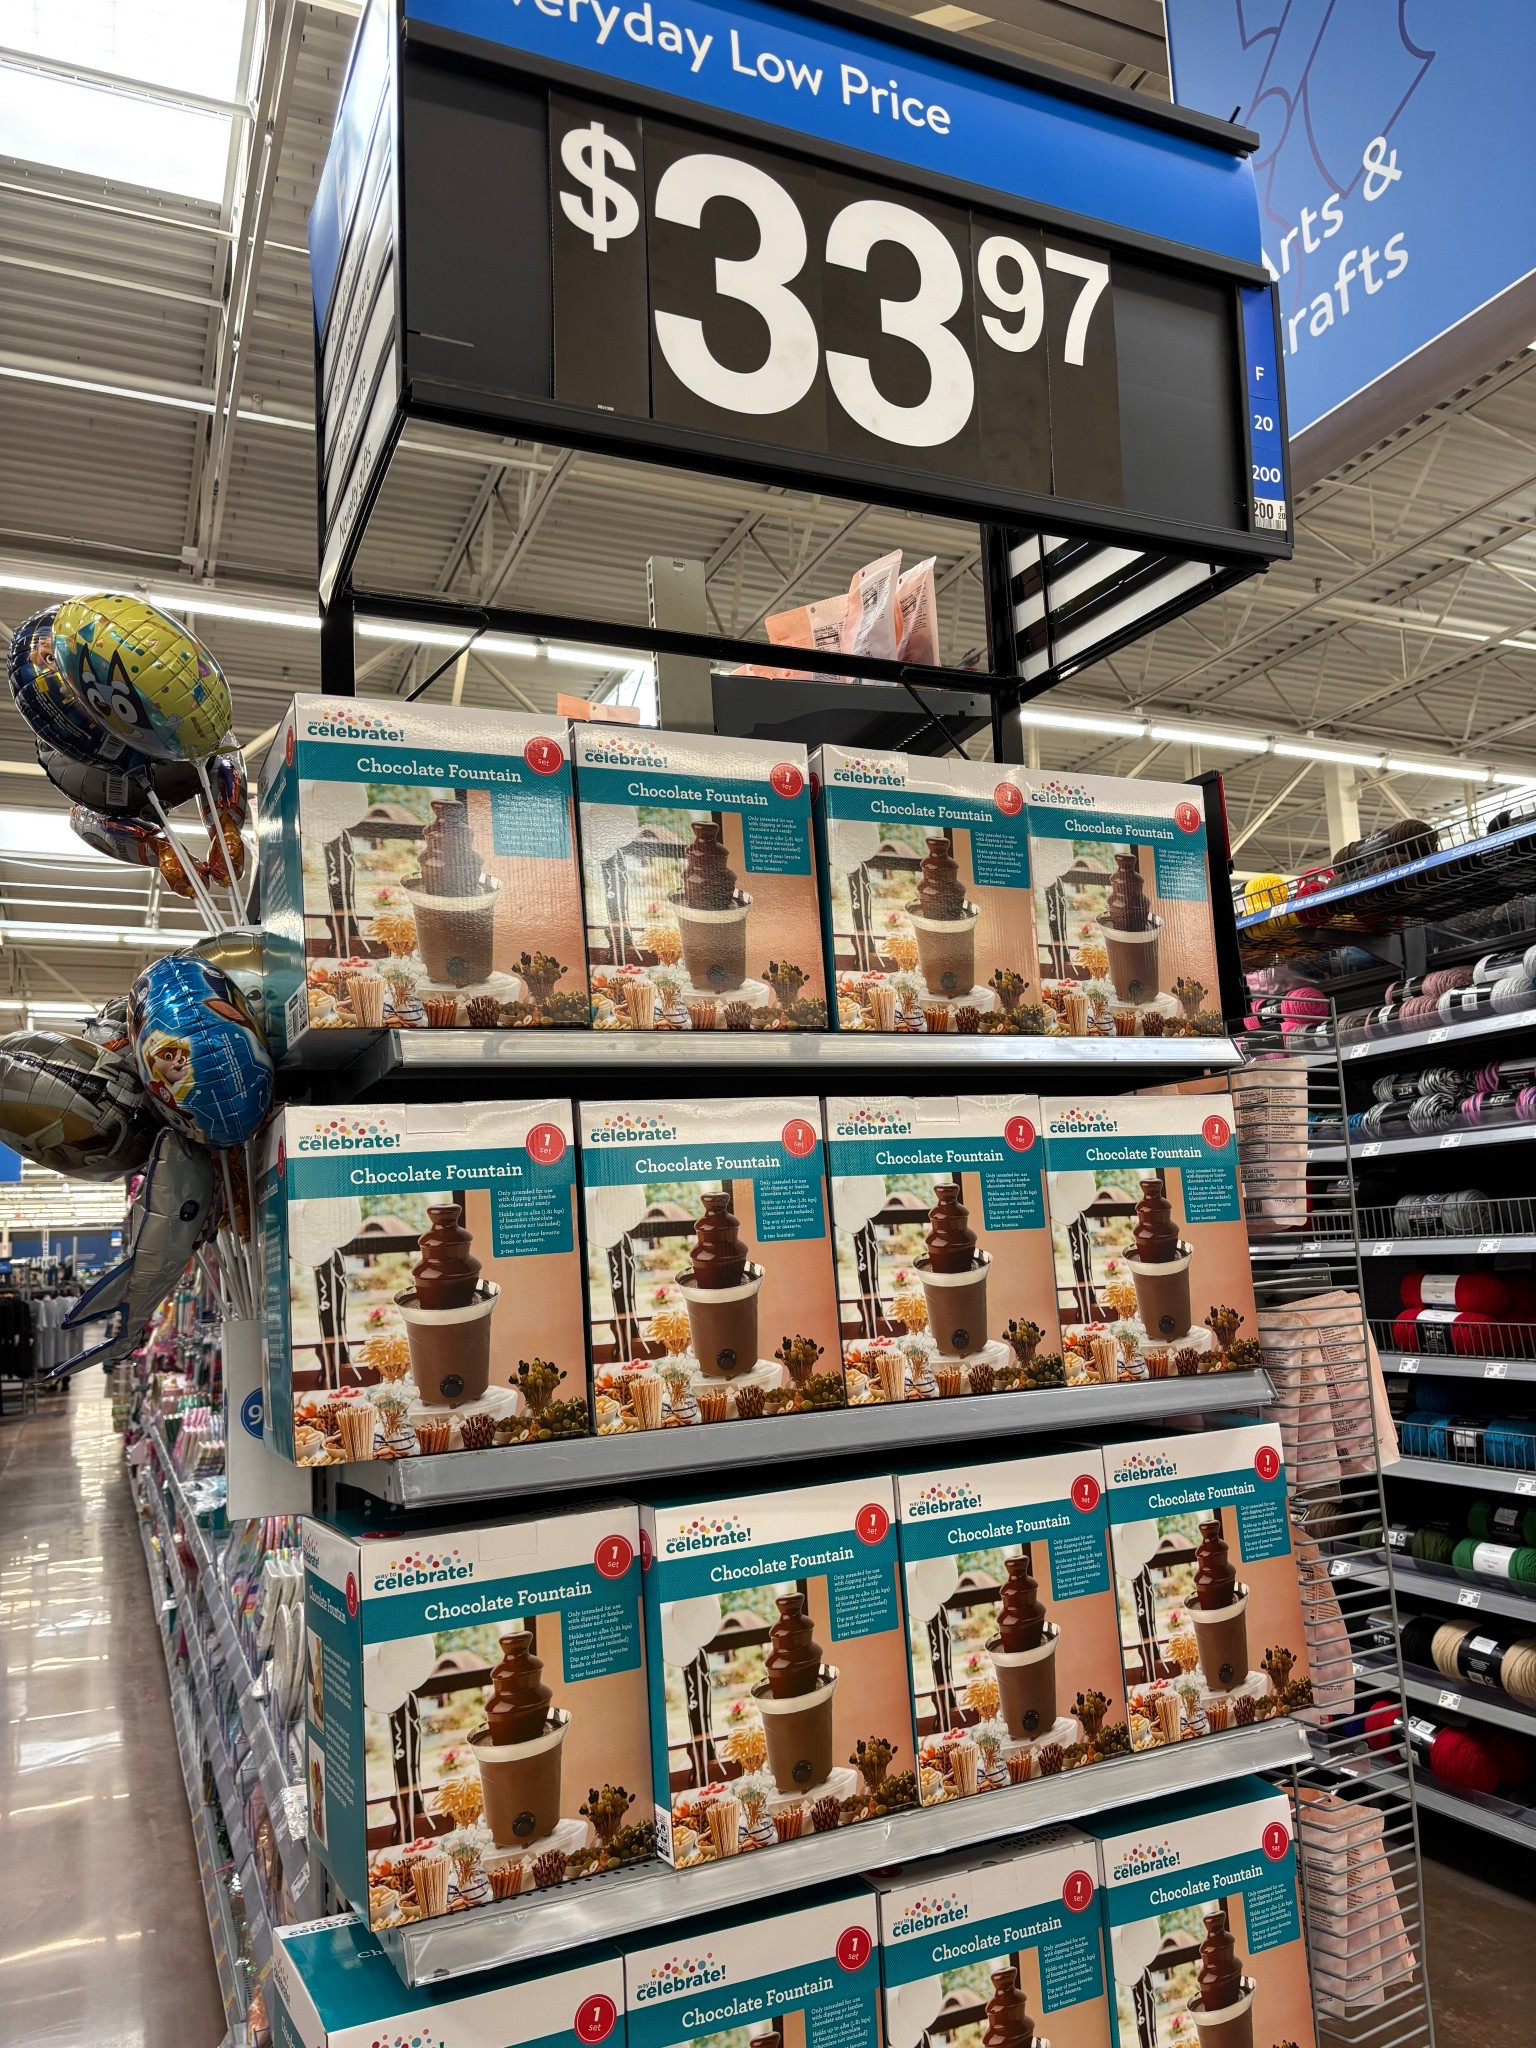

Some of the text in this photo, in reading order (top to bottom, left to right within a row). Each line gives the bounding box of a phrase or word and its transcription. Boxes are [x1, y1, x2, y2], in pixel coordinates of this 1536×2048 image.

[513, 0, 951, 135] eryday Low Price
[1362, 136, 1403, 202] &
[1281, 232, 1409, 356] rafts
[1255, 366, 1264, 381] F
[1254, 415, 1273, 432] 20
[1252, 465, 1281, 483] 200
[306, 723, 404, 742] celebrate!
[541, 744, 549, 758] 1
[585, 751, 667, 768] celebrate!
[356, 757, 523, 782] Chocolate Fountain
[783, 770, 791, 783] 1
[833, 770, 905, 787] celebrate!
[627, 782, 769, 805] Chocolate Fountain
[1005, 789, 1012, 801] 1
[1031, 791, 1096, 807] celebrate!
[870, 800, 993, 822] Chocolate Fountain
[1186, 809, 1193, 820] 1
[1064, 819, 1175, 840] Chocolate Fountain
[1293, 900, 1304, 909] Ask
[1305, 897, 1314, 905] for
[1316, 887, 1344, 902] assistance
[1346, 883, 1359, 893] with
[1360, 878, 1377, 889] items
[1387, 871, 1397, 879] the
[1398, 867, 1409, 875] top
[591, 1127, 676, 1142] celebrate!
[795, 1127, 803, 1140] 1
[837, 1122, 911, 1135] celebrate!
[1016, 1123, 1024, 1136] 1
[1050, 1121, 1118, 1133] celebrate!
[1213, 1122, 1220, 1134] 1
[298, 1133, 400, 1151] celebrate!
[542, 1132, 552, 1146] 1
[875, 1149, 1004, 1165] Chocolate Fountain
[1086, 1146, 1202, 1161] Chocolate Fountain
[635, 1155, 780, 1173] Chocolate Fountain
[350, 1163, 523, 1184] Chocolate Fountain
[1265, 1454, 1272, 1466] 1
[1114, 1463, 1177, 1483] celebrate!
[1082, 1482, 1090, 1496] 1
[1148, 1482, 1256, 1508] Chocolate Fountain
[909, 1494, 982, 1517] celebrate!
[869, 1513, 877, 1527] 1
[947, 1513, 1071, 1544] Chocolate Fountain
[666, 1528, 751, 1554] celebrate!
[610, 1545, 619, 1560] 1
[710, 1547, 854, 1582] Chocolate Fountain
[373, 1562, 473, 1591] celebrate!
[424, 1581, 592, 1621] Chocolate Fountain
[567, 1609, 581, 1619] Only
[581, 1605, 604, 1615] intended
[567, 1616, 580, 1625] with
[580, 1613, 600, 1624] dipping
[606, 1608, 624, 1617] fondue
[567, 1620, 593, 1631] chocolate
[603, 1616, 619, 1625] candy
[568, 1631, 584, 1641] Holds
[569, 1642, 596, 1654] (chocolate
[605, 1635, 629, 1647] included)
[575, 1636, 598, 1646] fountain
[597, 1631, 622, 1641] chocolate
[569, 1645, 629, 1664] Dip any of your favorite
[569, 1660, 585, 1669] foods
[591, 1655, 614, 1665] desserts.
[570, 1665, 607, 1680] 3-tier fountain
[1273, 1831, 1280, 1845] 1
[1113, 1852, 1181, 1880] celebrate!
[1075, 1879, 1082, 1894] 1
[1149, 1865, 1263, 1905] Chocolate Fountain
[892, 1904, 968, 1937] celebrate!
[851, 1935, 859, 1952] 1
[932, 1916, 1062, 1962] Chocolate Fountain
[636, 1965, 725, 2001] celebrate!
[682, 1976, 834, 2027] Chocolate Fountain
[593, 2006, 601, 2022] 1
[588, 2023, 602, 2032] set
